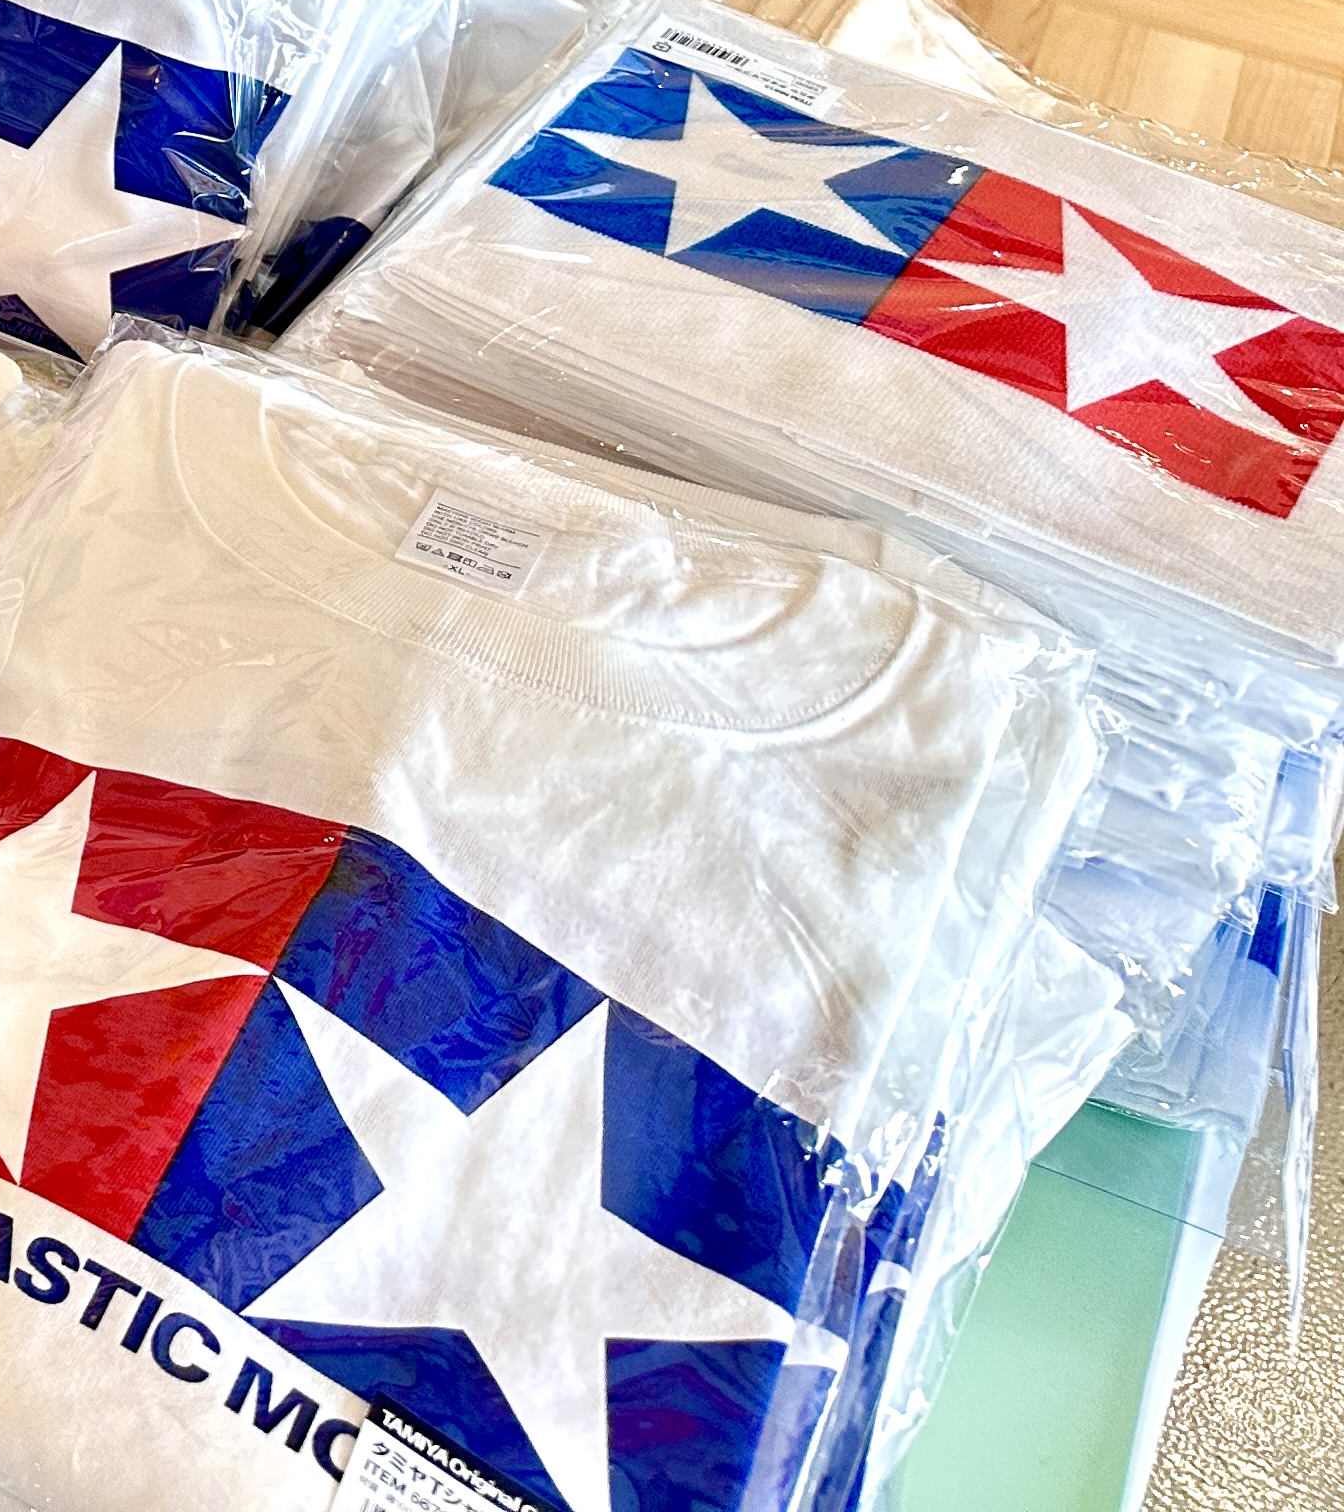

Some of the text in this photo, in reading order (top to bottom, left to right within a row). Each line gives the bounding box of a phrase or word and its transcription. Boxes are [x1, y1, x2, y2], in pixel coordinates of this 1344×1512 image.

[364, 1458, 407, 1497] ITEM
[382, 1408, 523, 1512] TAMIYA Original
